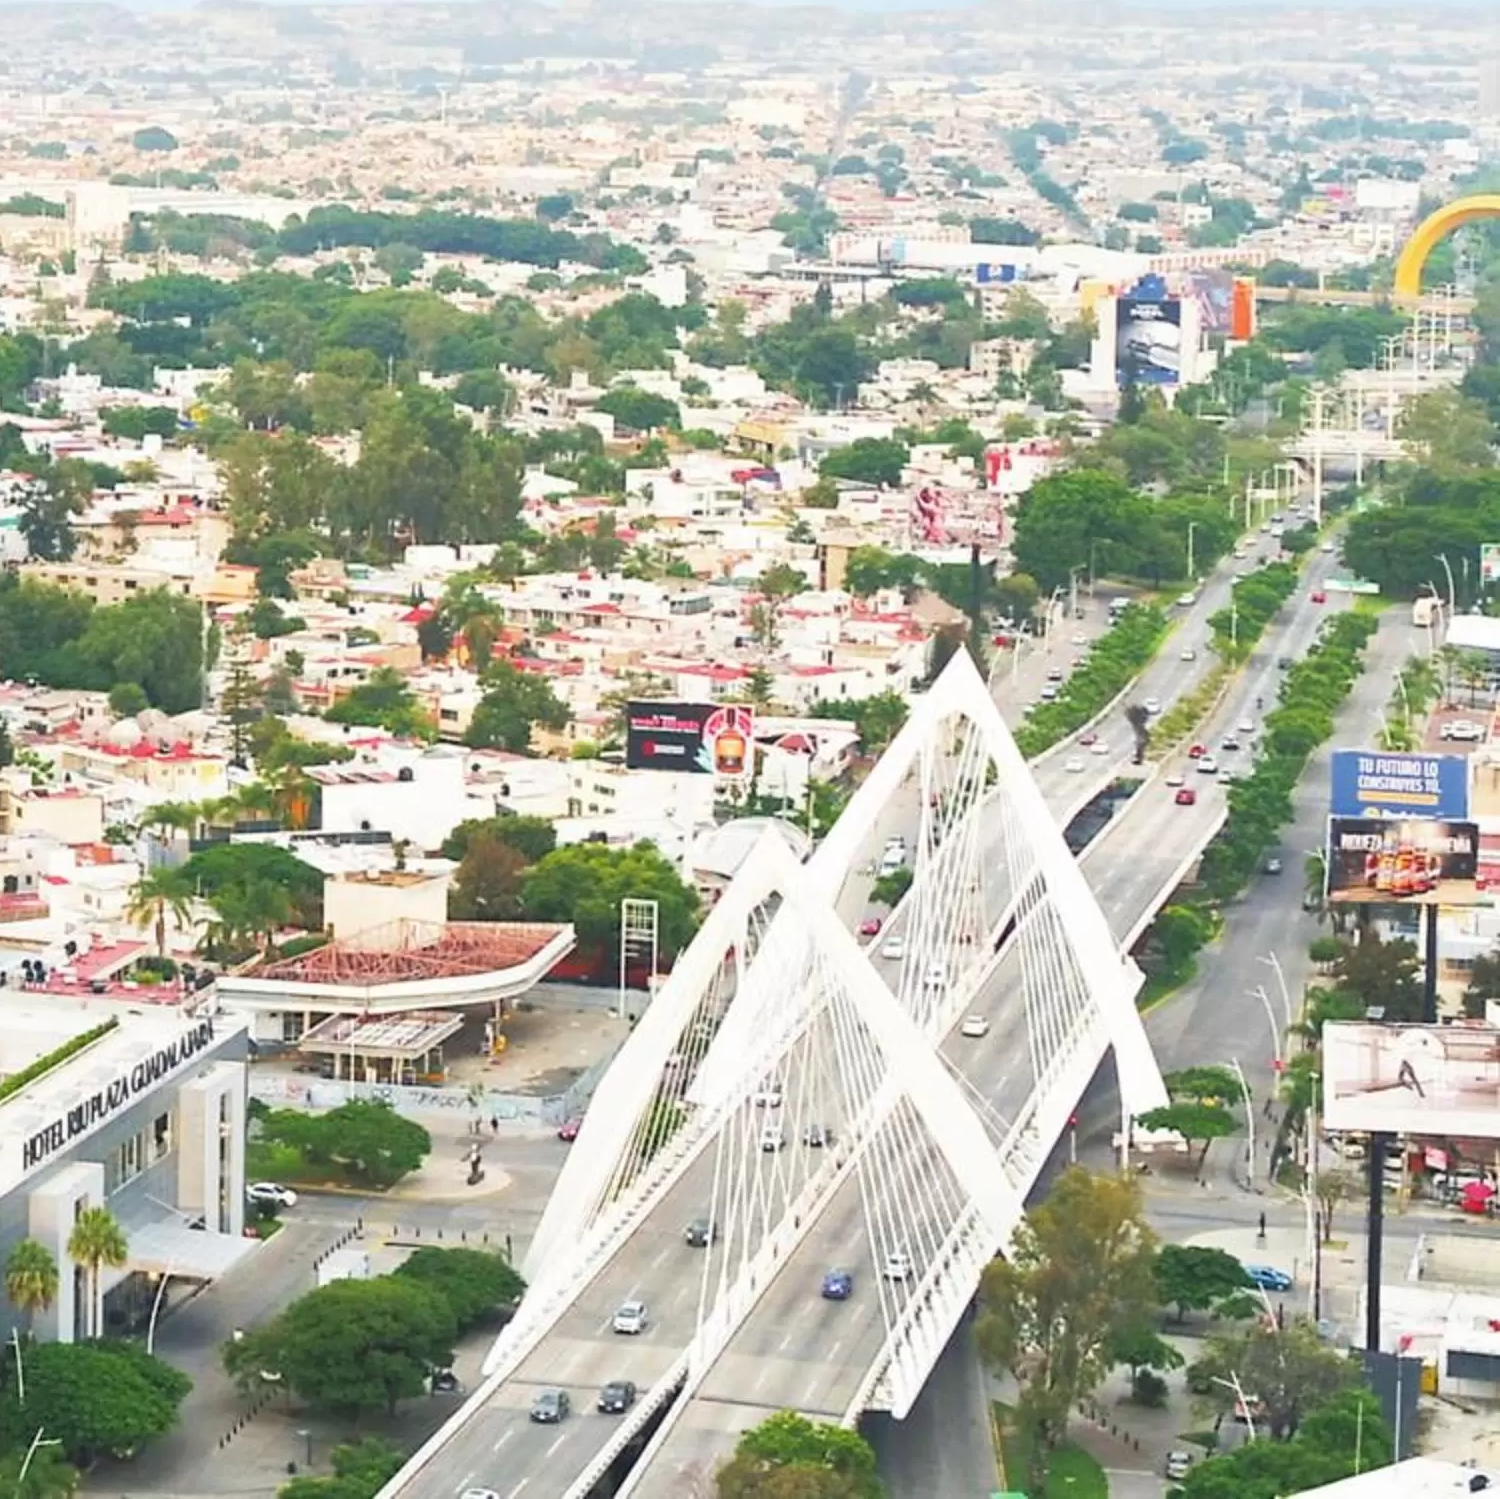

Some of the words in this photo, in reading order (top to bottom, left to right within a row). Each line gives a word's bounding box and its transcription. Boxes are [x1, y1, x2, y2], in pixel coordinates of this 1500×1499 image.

[23, 1118, 66, 1171] HOTEL
[67, 1100, 89, 1140] RIU
[91, 1076, 129, 1123] PLAZA
